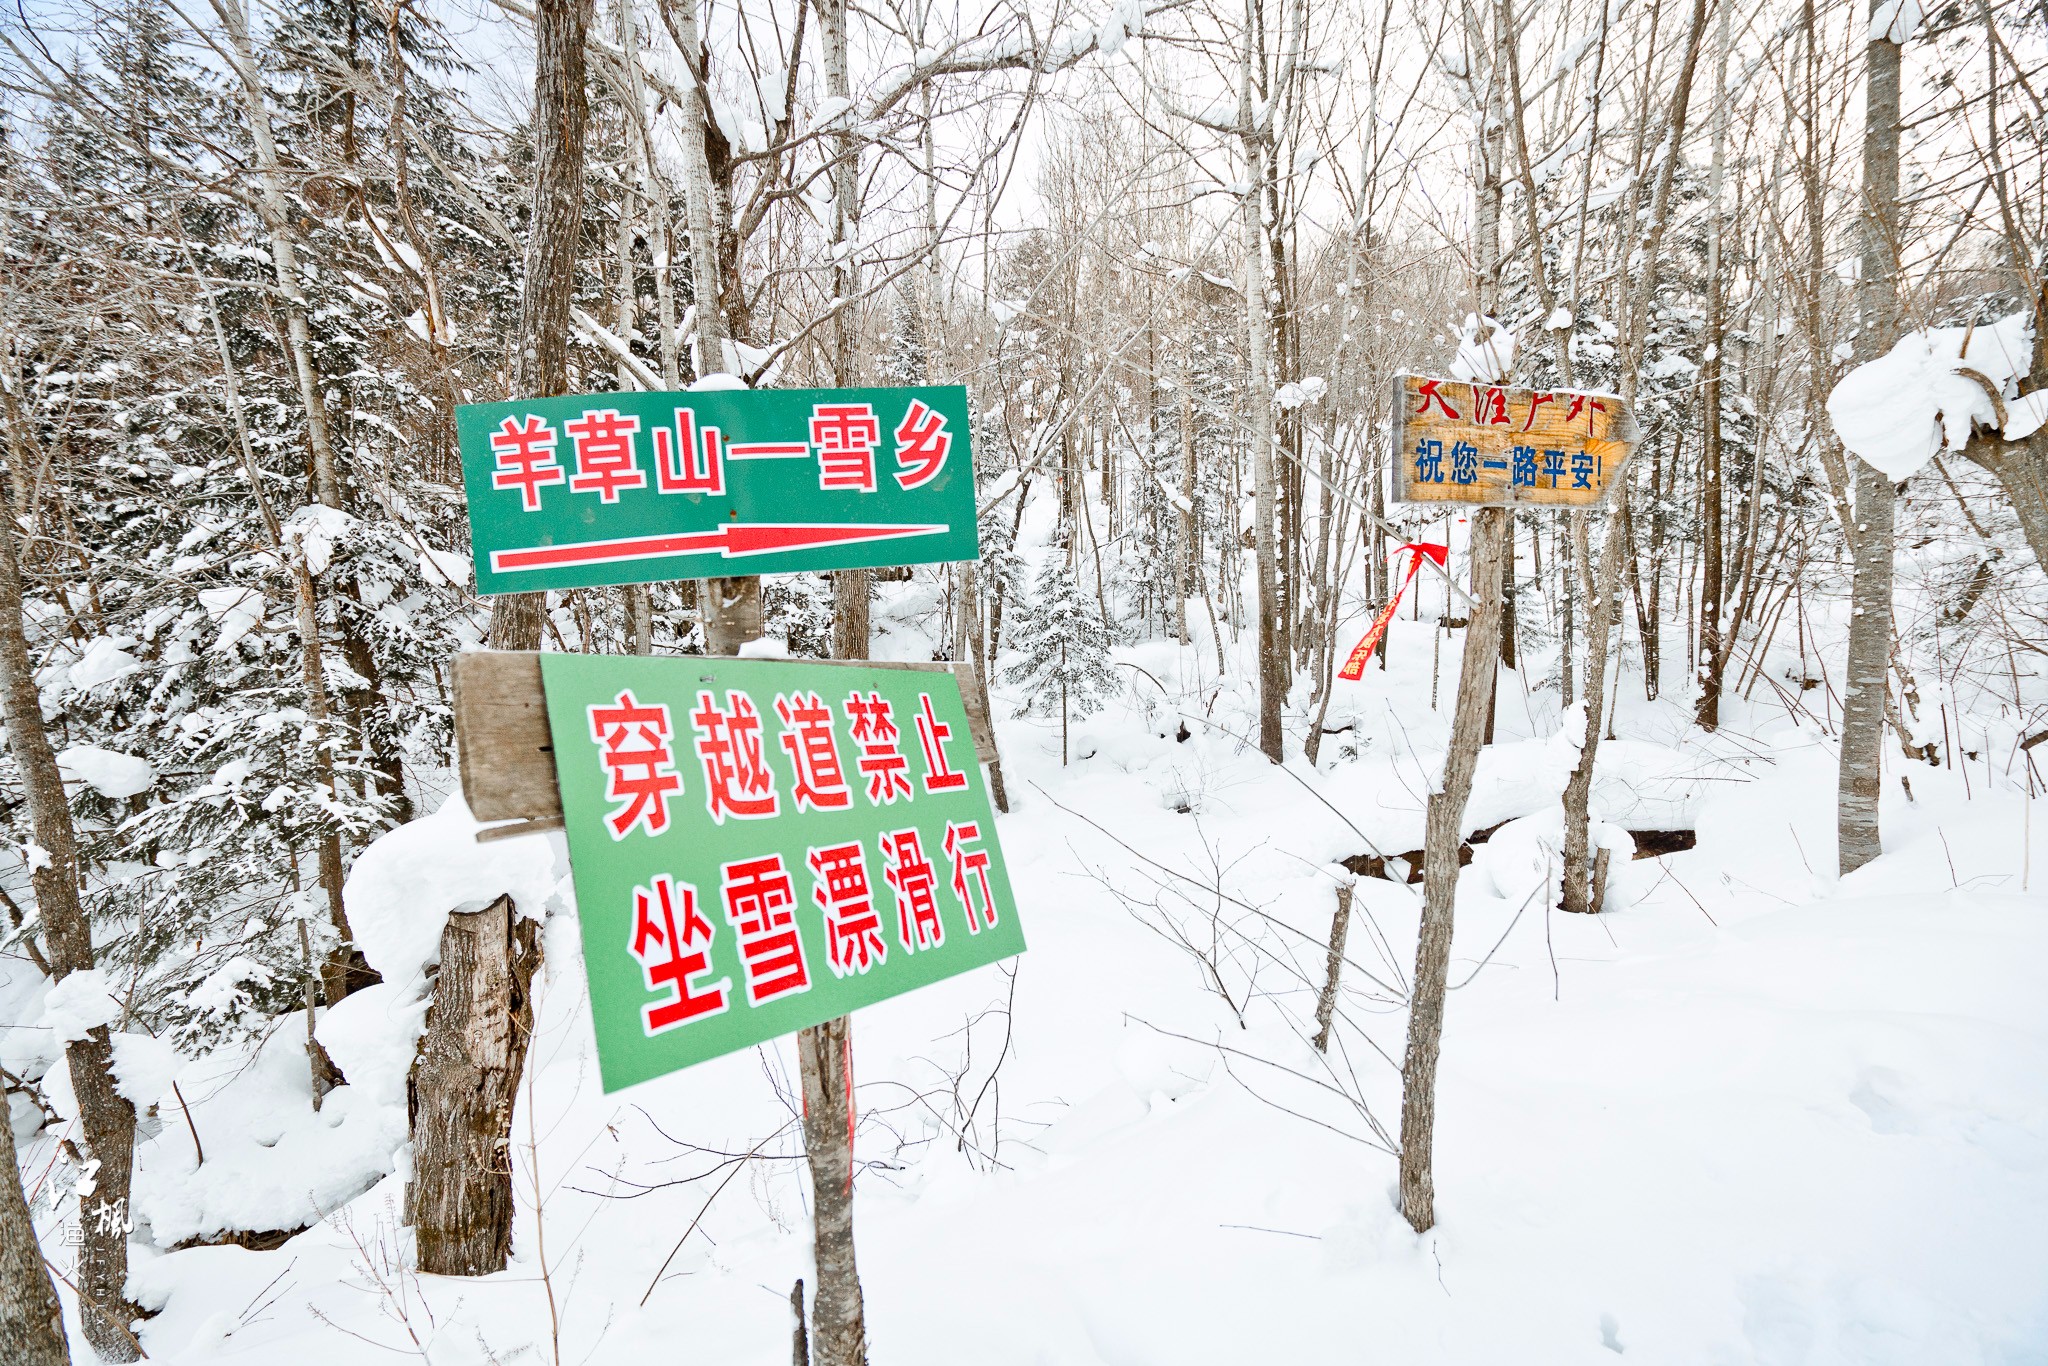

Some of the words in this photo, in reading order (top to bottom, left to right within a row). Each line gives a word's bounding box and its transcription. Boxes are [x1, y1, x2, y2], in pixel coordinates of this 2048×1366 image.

[1415, 438, 1601, 489] 祝您一路平安!
[586, 687, 969, 841] 穿越道禁止
[626, 820, 999, 1037] 坐雪漂滑行
